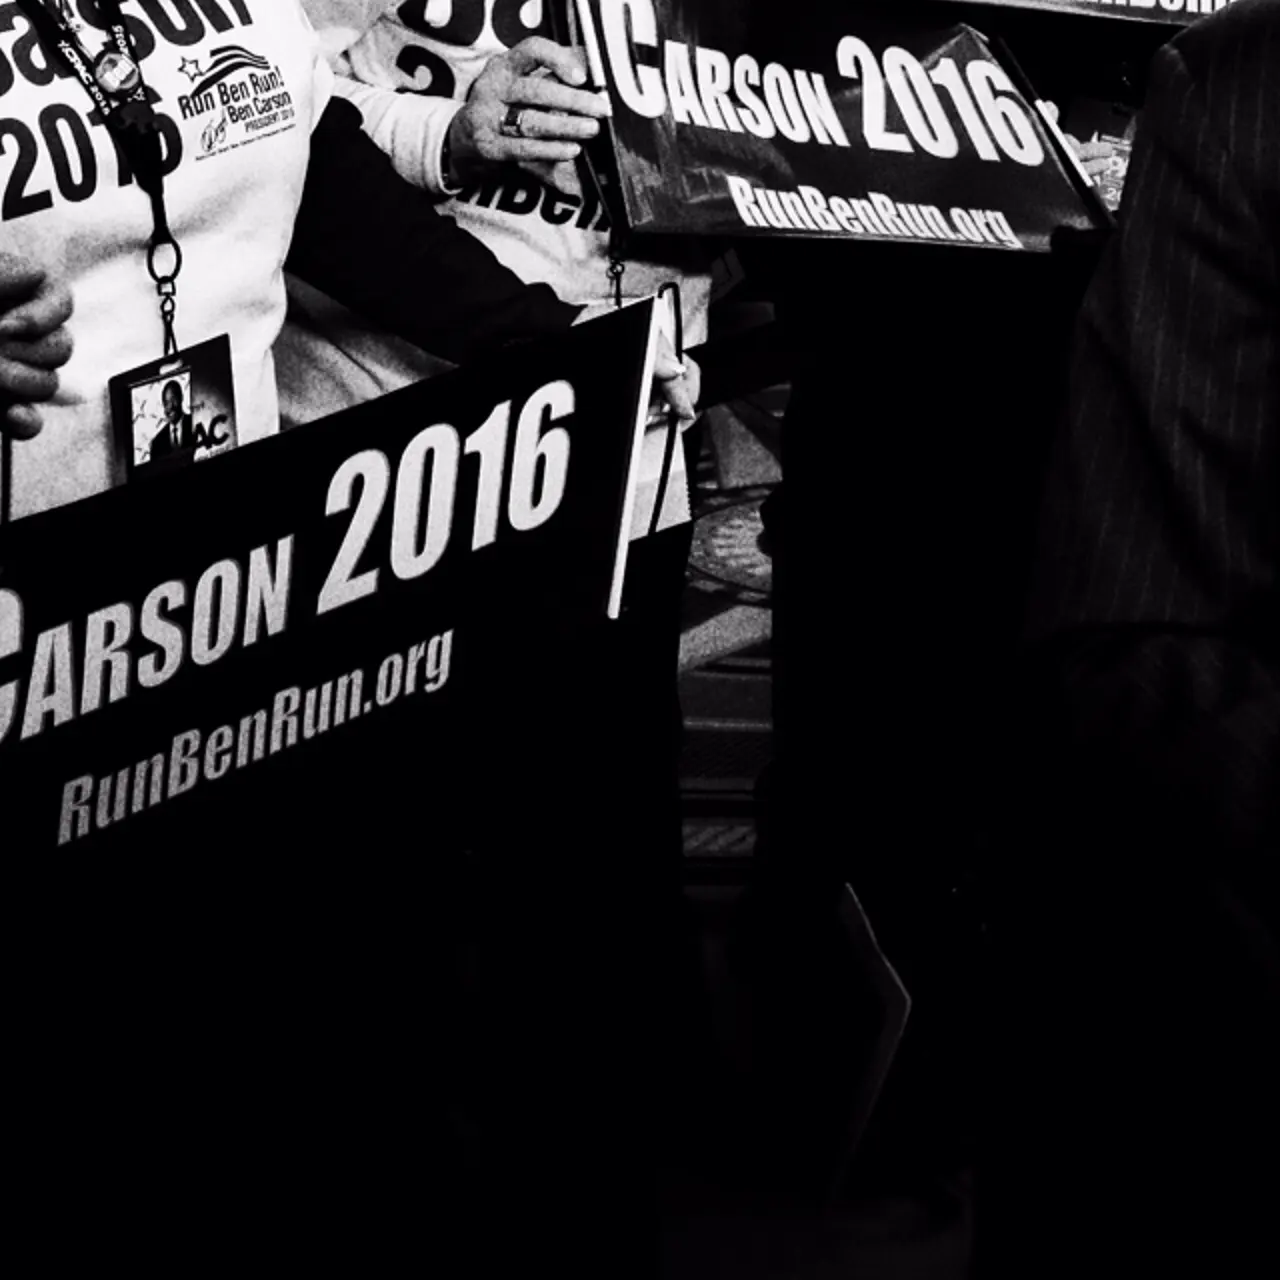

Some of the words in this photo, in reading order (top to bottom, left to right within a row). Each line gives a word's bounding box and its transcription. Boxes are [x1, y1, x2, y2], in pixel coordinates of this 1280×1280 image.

[177, 91, 216, 120] Run
[217, 80, 251, 106] Ben
[227, 103, 255, 124] Ben
[253, 91, 293, 115] Carson
[837, 35, 1046, 166] 2016
[725, 174, 1025, 250] RunBenRun.org
[317, 378, 576, 616] 2016
[56, 627, 455, 848] RunBenRun.org
